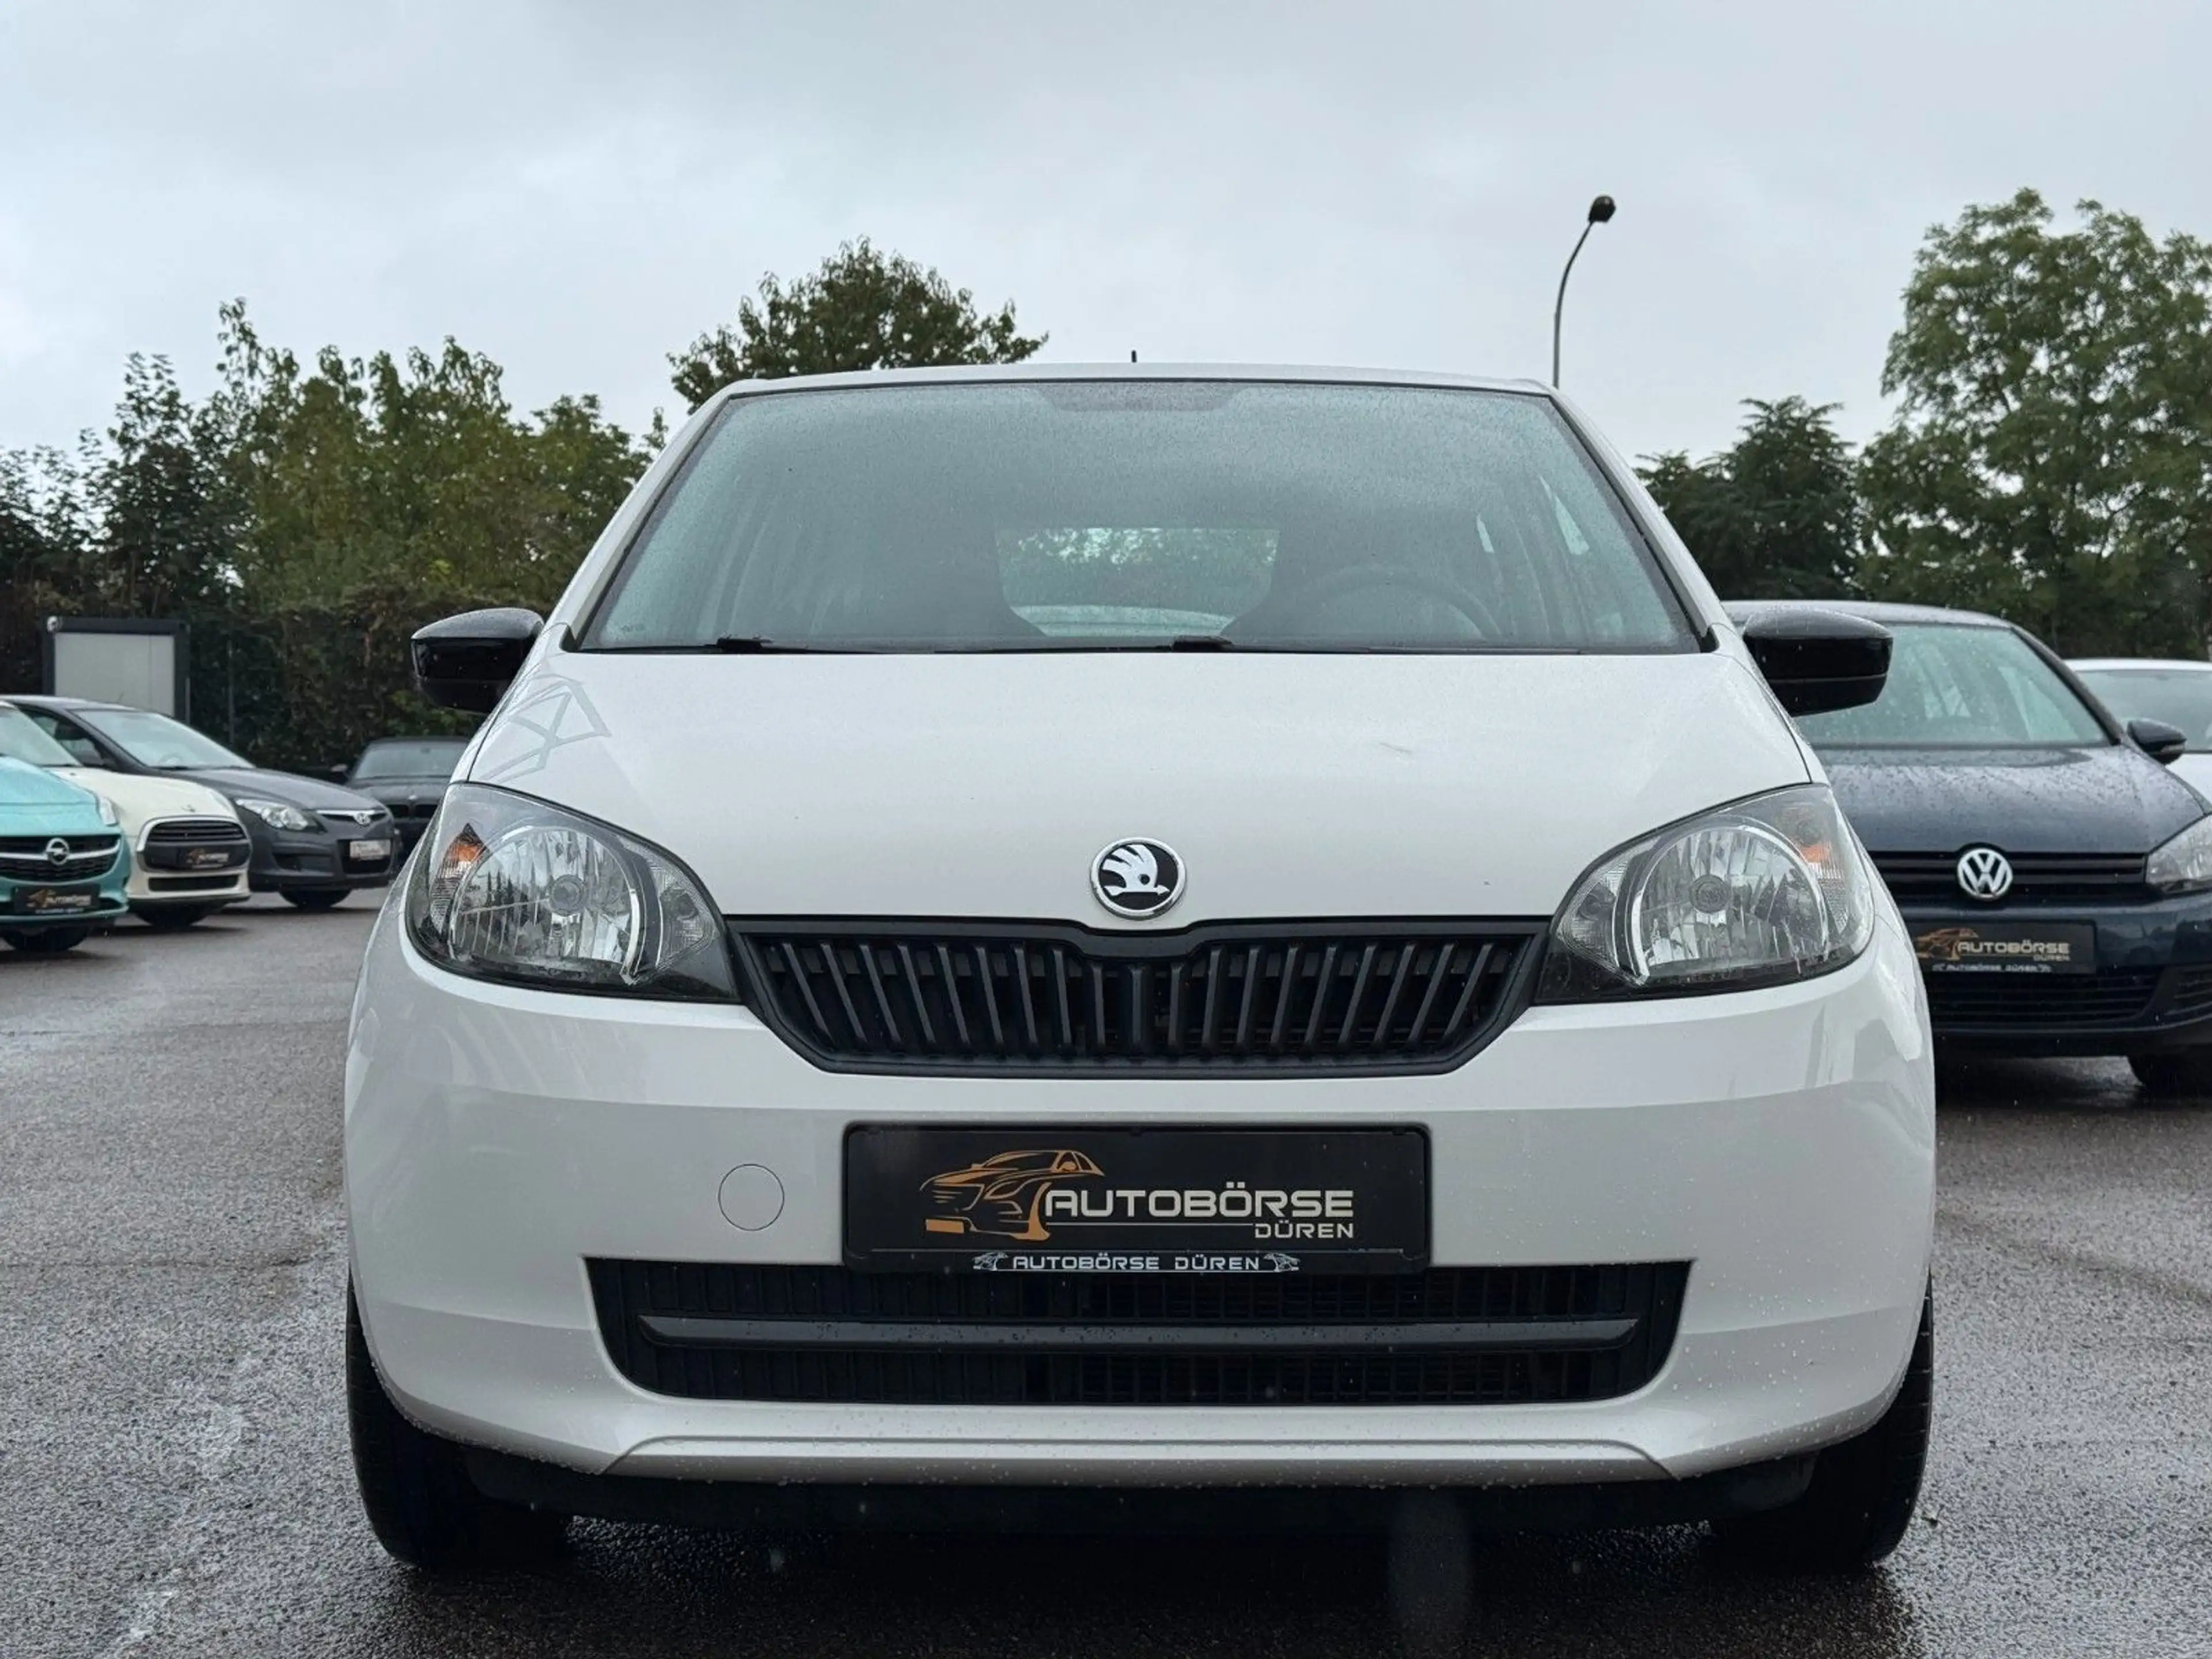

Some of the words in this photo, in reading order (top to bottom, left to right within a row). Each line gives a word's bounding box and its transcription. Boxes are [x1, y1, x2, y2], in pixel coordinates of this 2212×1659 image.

[1958, 938, 2070, 953] AUTOBÖRSE
[1045, 1181, 1354, 1217] AUTOBÖRSE
[1254, 1219, 1354, 1238] DÜREN
[1013, 1252, 1160, 1270] AUTOBÖRSE
[1175, 1253, 1259, 1270] DÜREN
